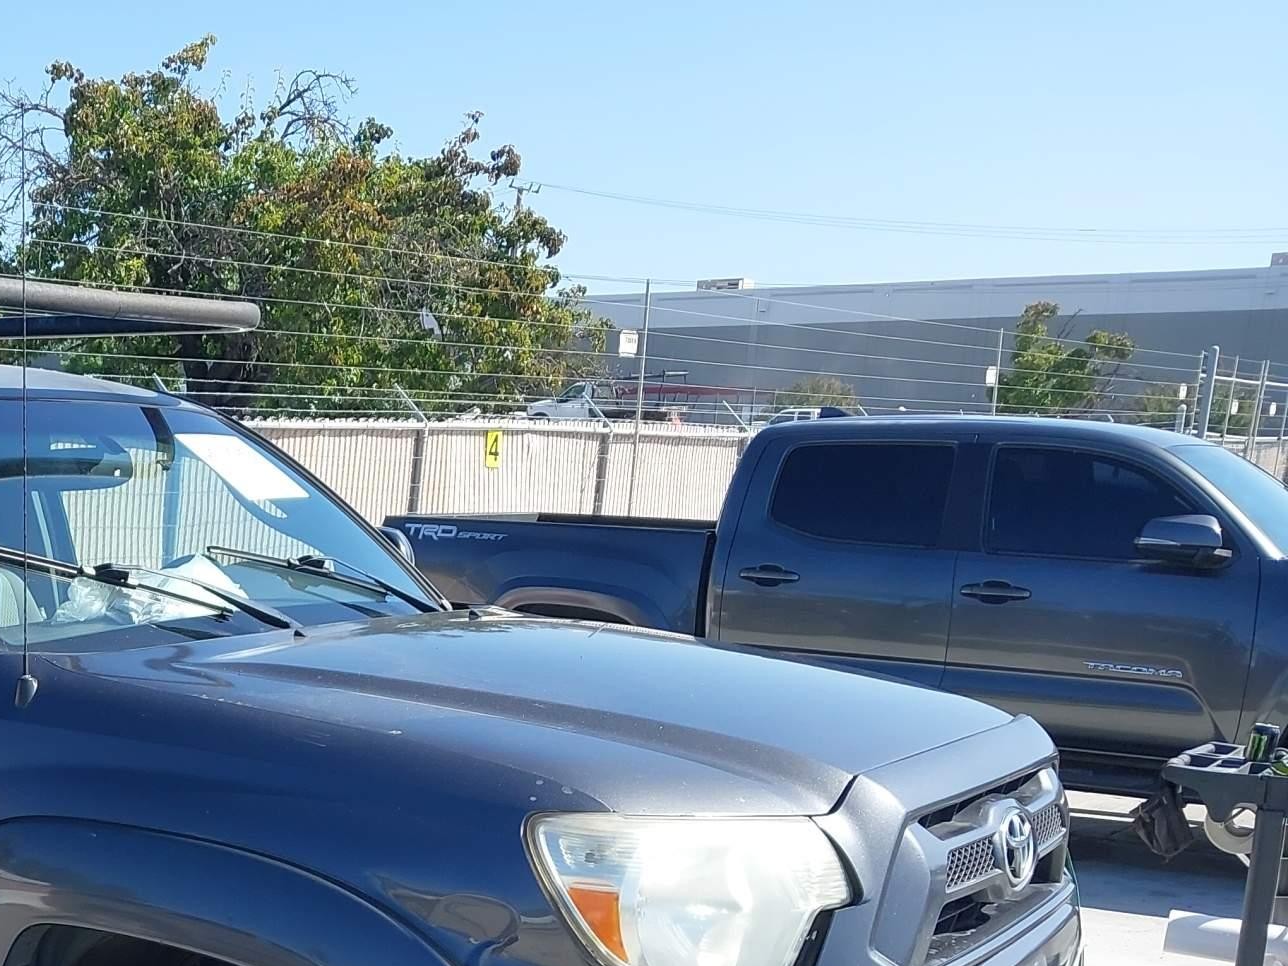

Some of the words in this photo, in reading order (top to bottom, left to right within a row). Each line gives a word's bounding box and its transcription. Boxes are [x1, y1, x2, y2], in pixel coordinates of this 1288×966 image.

[488, 434, 499, 461] 4
[404, 523, 458, 540] TRD
[457, 531, 509, 541] SPORT
[1082, 661, 1183, 678] TACOMA
